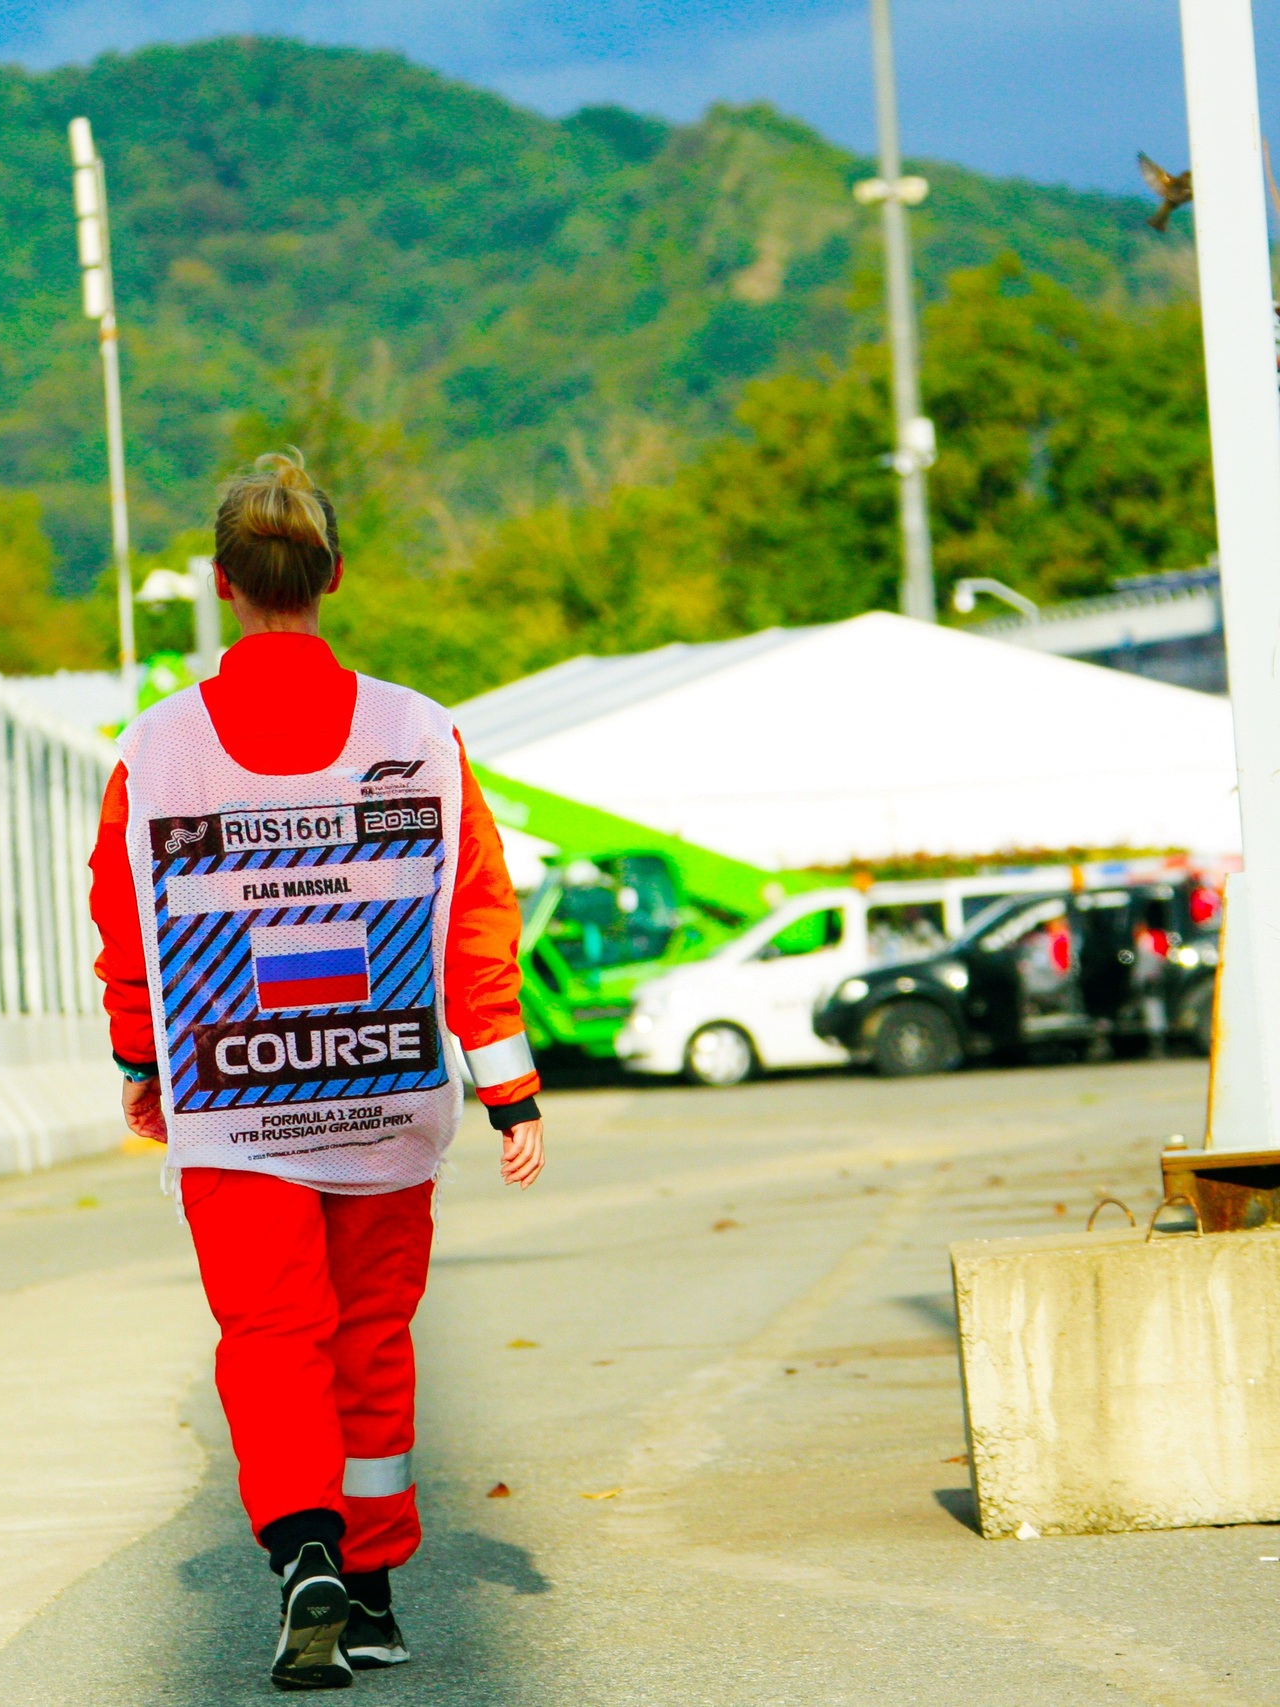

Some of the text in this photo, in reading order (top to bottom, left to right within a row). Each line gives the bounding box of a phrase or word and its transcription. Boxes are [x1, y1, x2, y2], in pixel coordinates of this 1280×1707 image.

[224, 815, 344, 845] RUS1601
[363, 807, 438, 834] 2018
[242, 876, 352, 901] FLAG MARSHAL
[215, 1021, 421, 1076] COURSE
[229, 1113, 415, 1144] VTB RUSSIAN GRAND PRIX
[261, 1105, 383, 1128] FORMULA 1 2018
